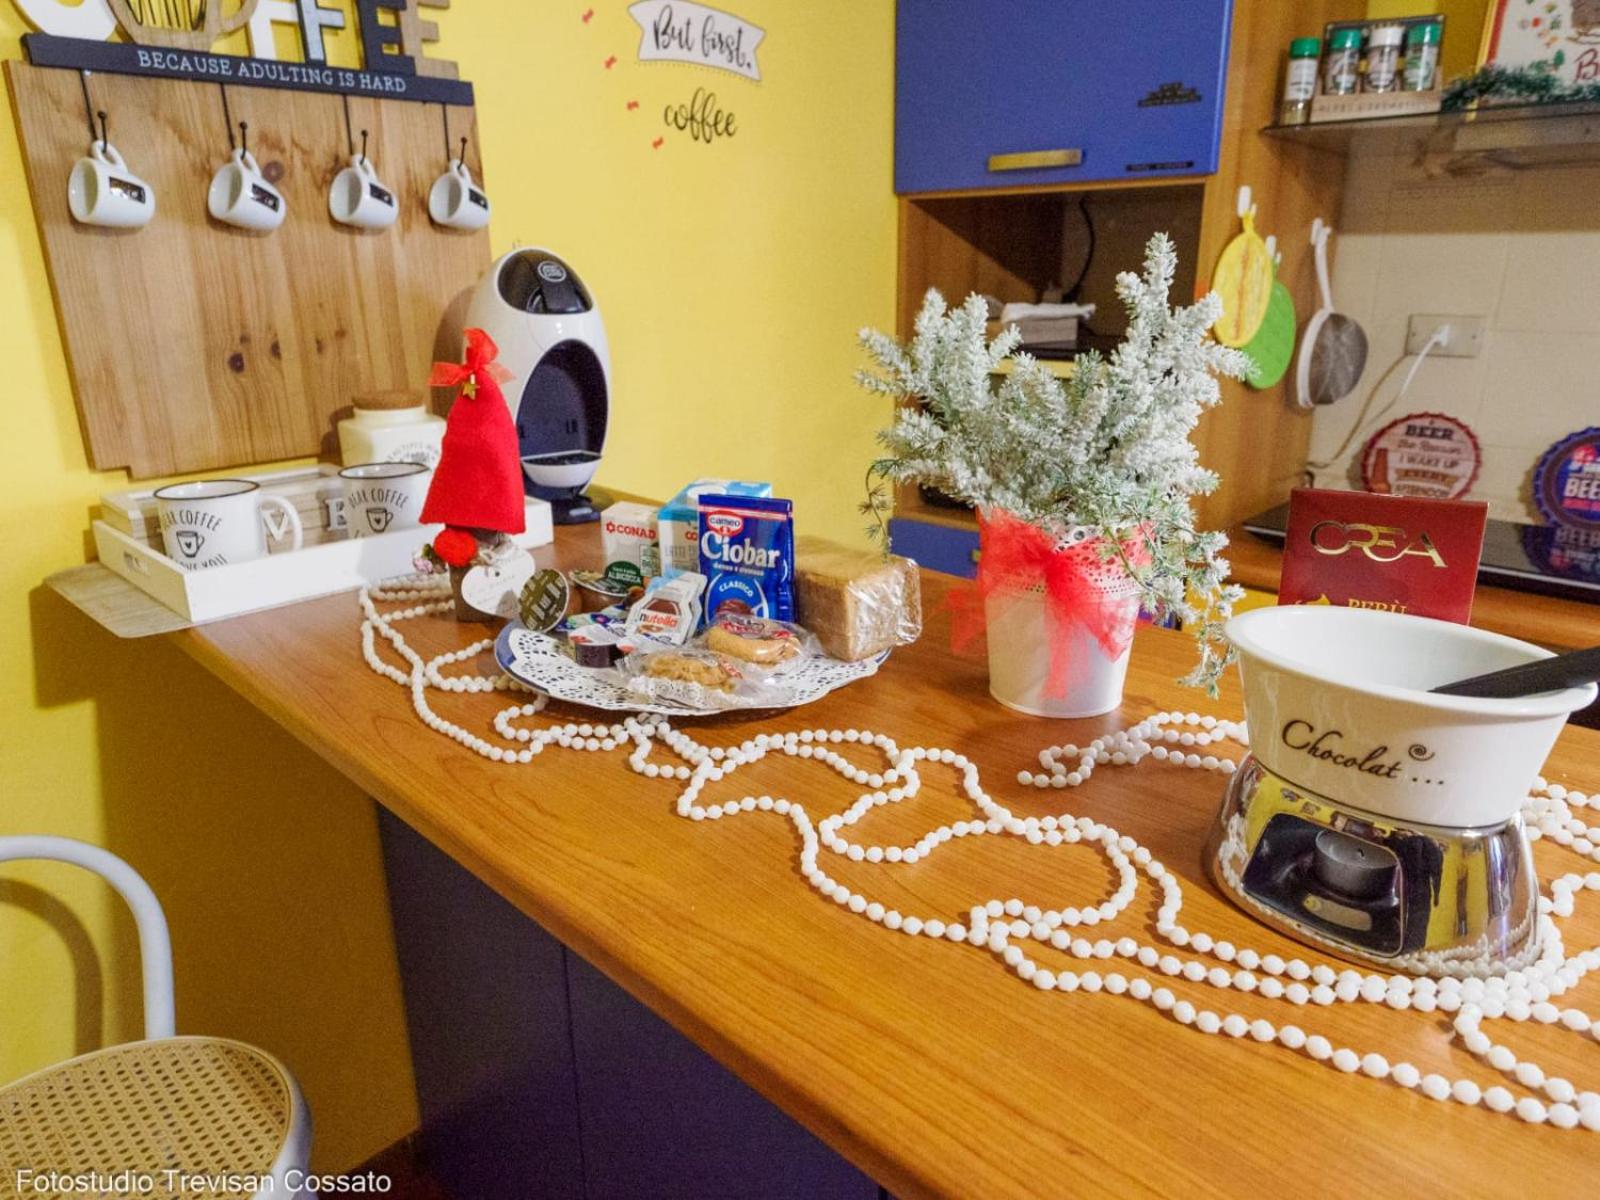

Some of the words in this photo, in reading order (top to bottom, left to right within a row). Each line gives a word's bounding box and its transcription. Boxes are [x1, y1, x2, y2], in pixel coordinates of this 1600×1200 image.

[653, 4, 694, 51] But
[137, 49, 232, 76] BECAUSE
[238, 61, 333, 86] ADULTING
[338, 71, 355, 88] IS
[360, 74, 406, 92] HARD
[664, 86, 737, 143] coffee
[1405, 424, 1455, 441] BEER
[370, 487, 409, 509] COFFEE
[1564, 476, 1600, 499] BEE
[179, 509, 223, 532] COFFEE
[616, 524, 657, 540] CONAD
[709, 516, 740, 527] cameo
[701, 530, 780, 568] Ciobar
[1310, 519, 1448, 568] CREA
[719, 580, 753, 598] CLASSICO
[639, 613, 678, 628] nutella
